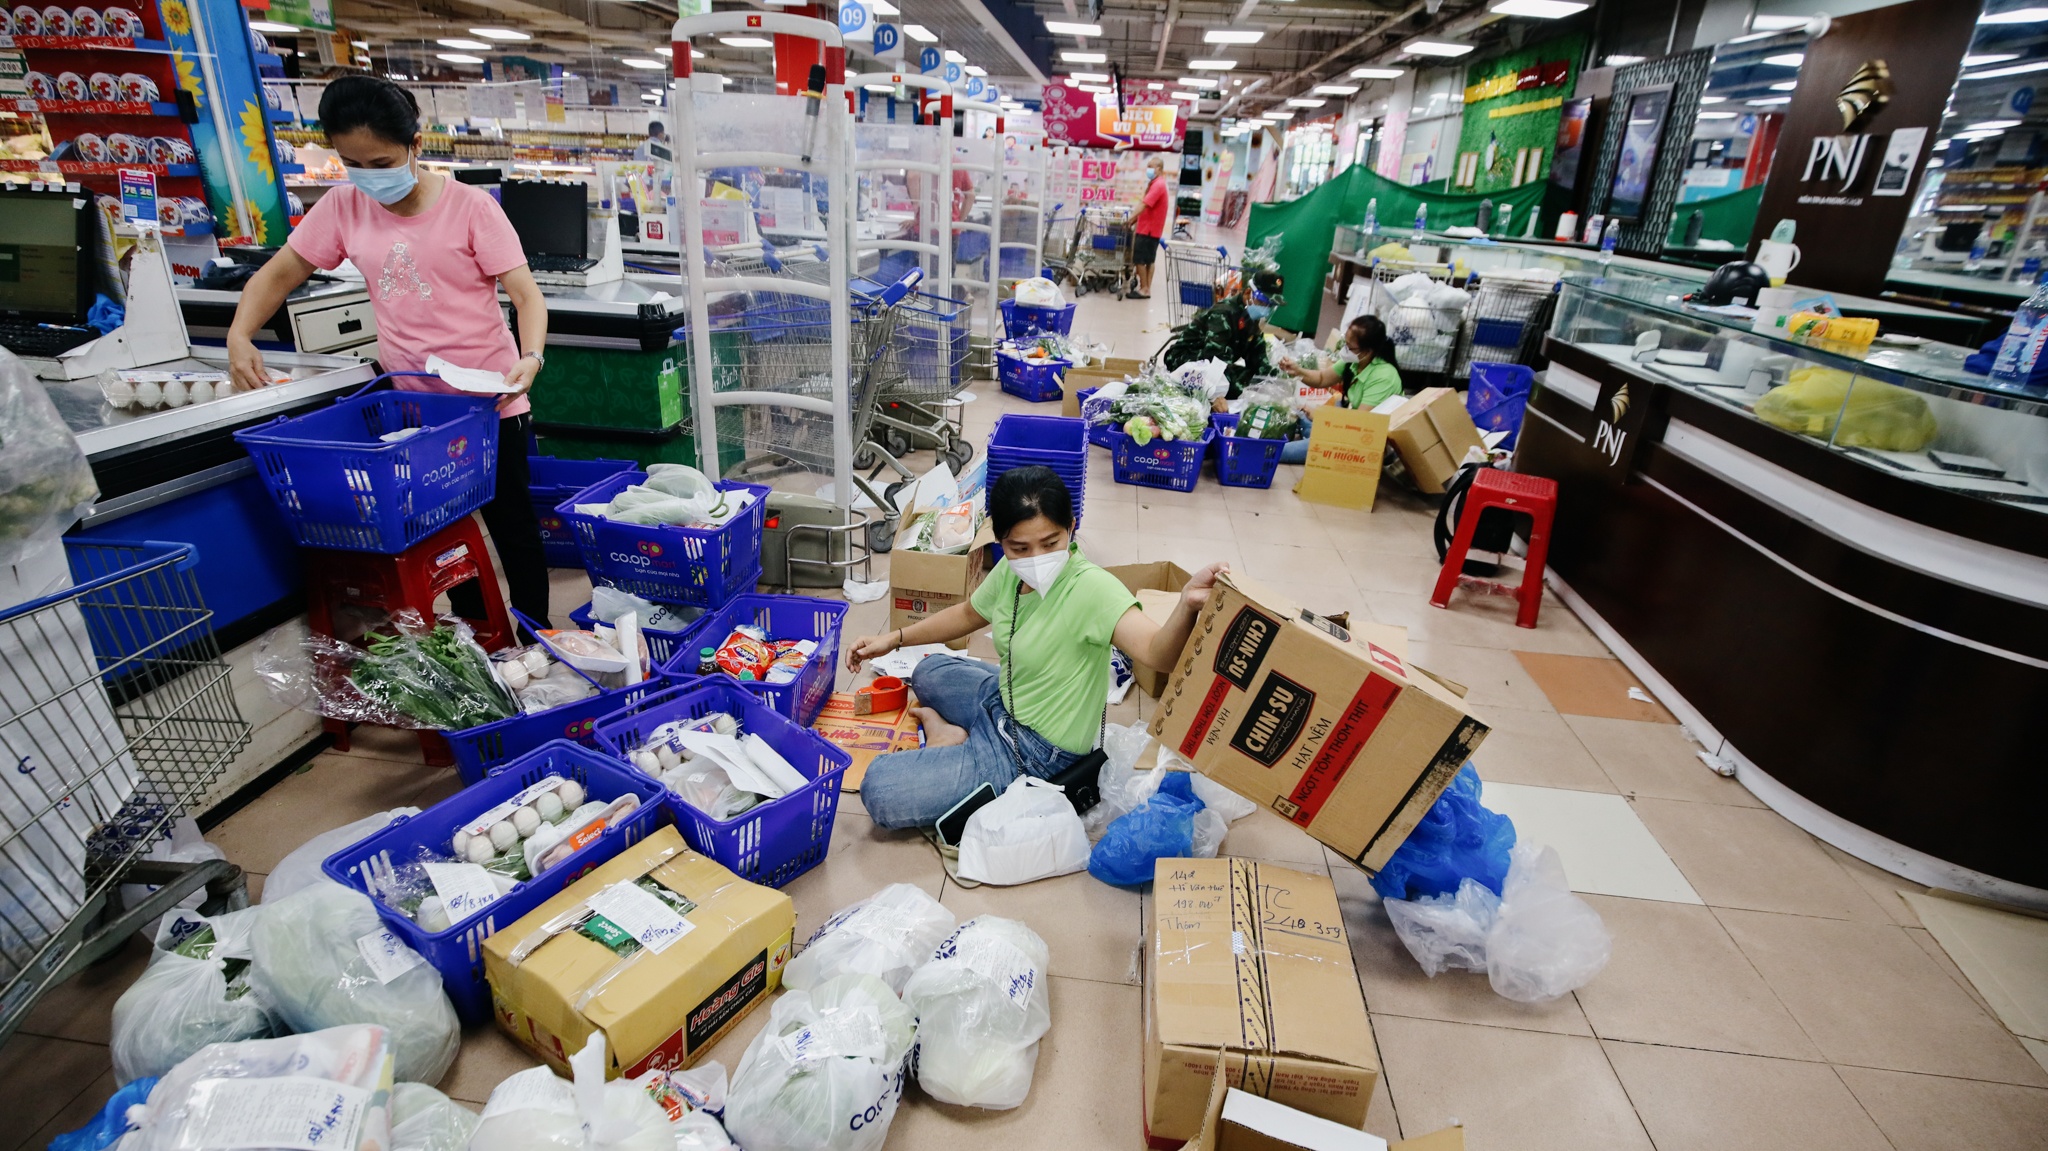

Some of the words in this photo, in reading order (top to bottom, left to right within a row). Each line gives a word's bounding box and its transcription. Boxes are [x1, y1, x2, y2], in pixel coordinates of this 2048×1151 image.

[841, 7, 863, 26] 09
[876, 30, 894, 46] 10
[923, 54, 936, 66] 11
[945, 67, 957, 79] 12
[970, 81, 981, 92] 15
[1800, 133, 1873, 194] PNJ
[1592, 419, 1628, 467] PNJ
[1134, 456, 1160, 466] co.op
[422, 461, 456, 487] co.op
[610, 552, 651, 568] co.op
[1228, 619, 1267, 680] CHIN-SU
[1245, 685, 1295, 753] CHIN-SU
[1291, 744, 1312, 770] HẠT
[1308, 717, 1332, 745] NÊM
[1296, 775, 1320, 802] NGỌT
[1314, 753, 1336, 777] TÔM
[1329, 724, 1355, 756] THƠM
[1348, 699, 1369, 725] THỊT
[577, 827, 603, 847] Select
[690, 981, 740, 1033] Hoàng
[741, 960, 765, 987] Gia
